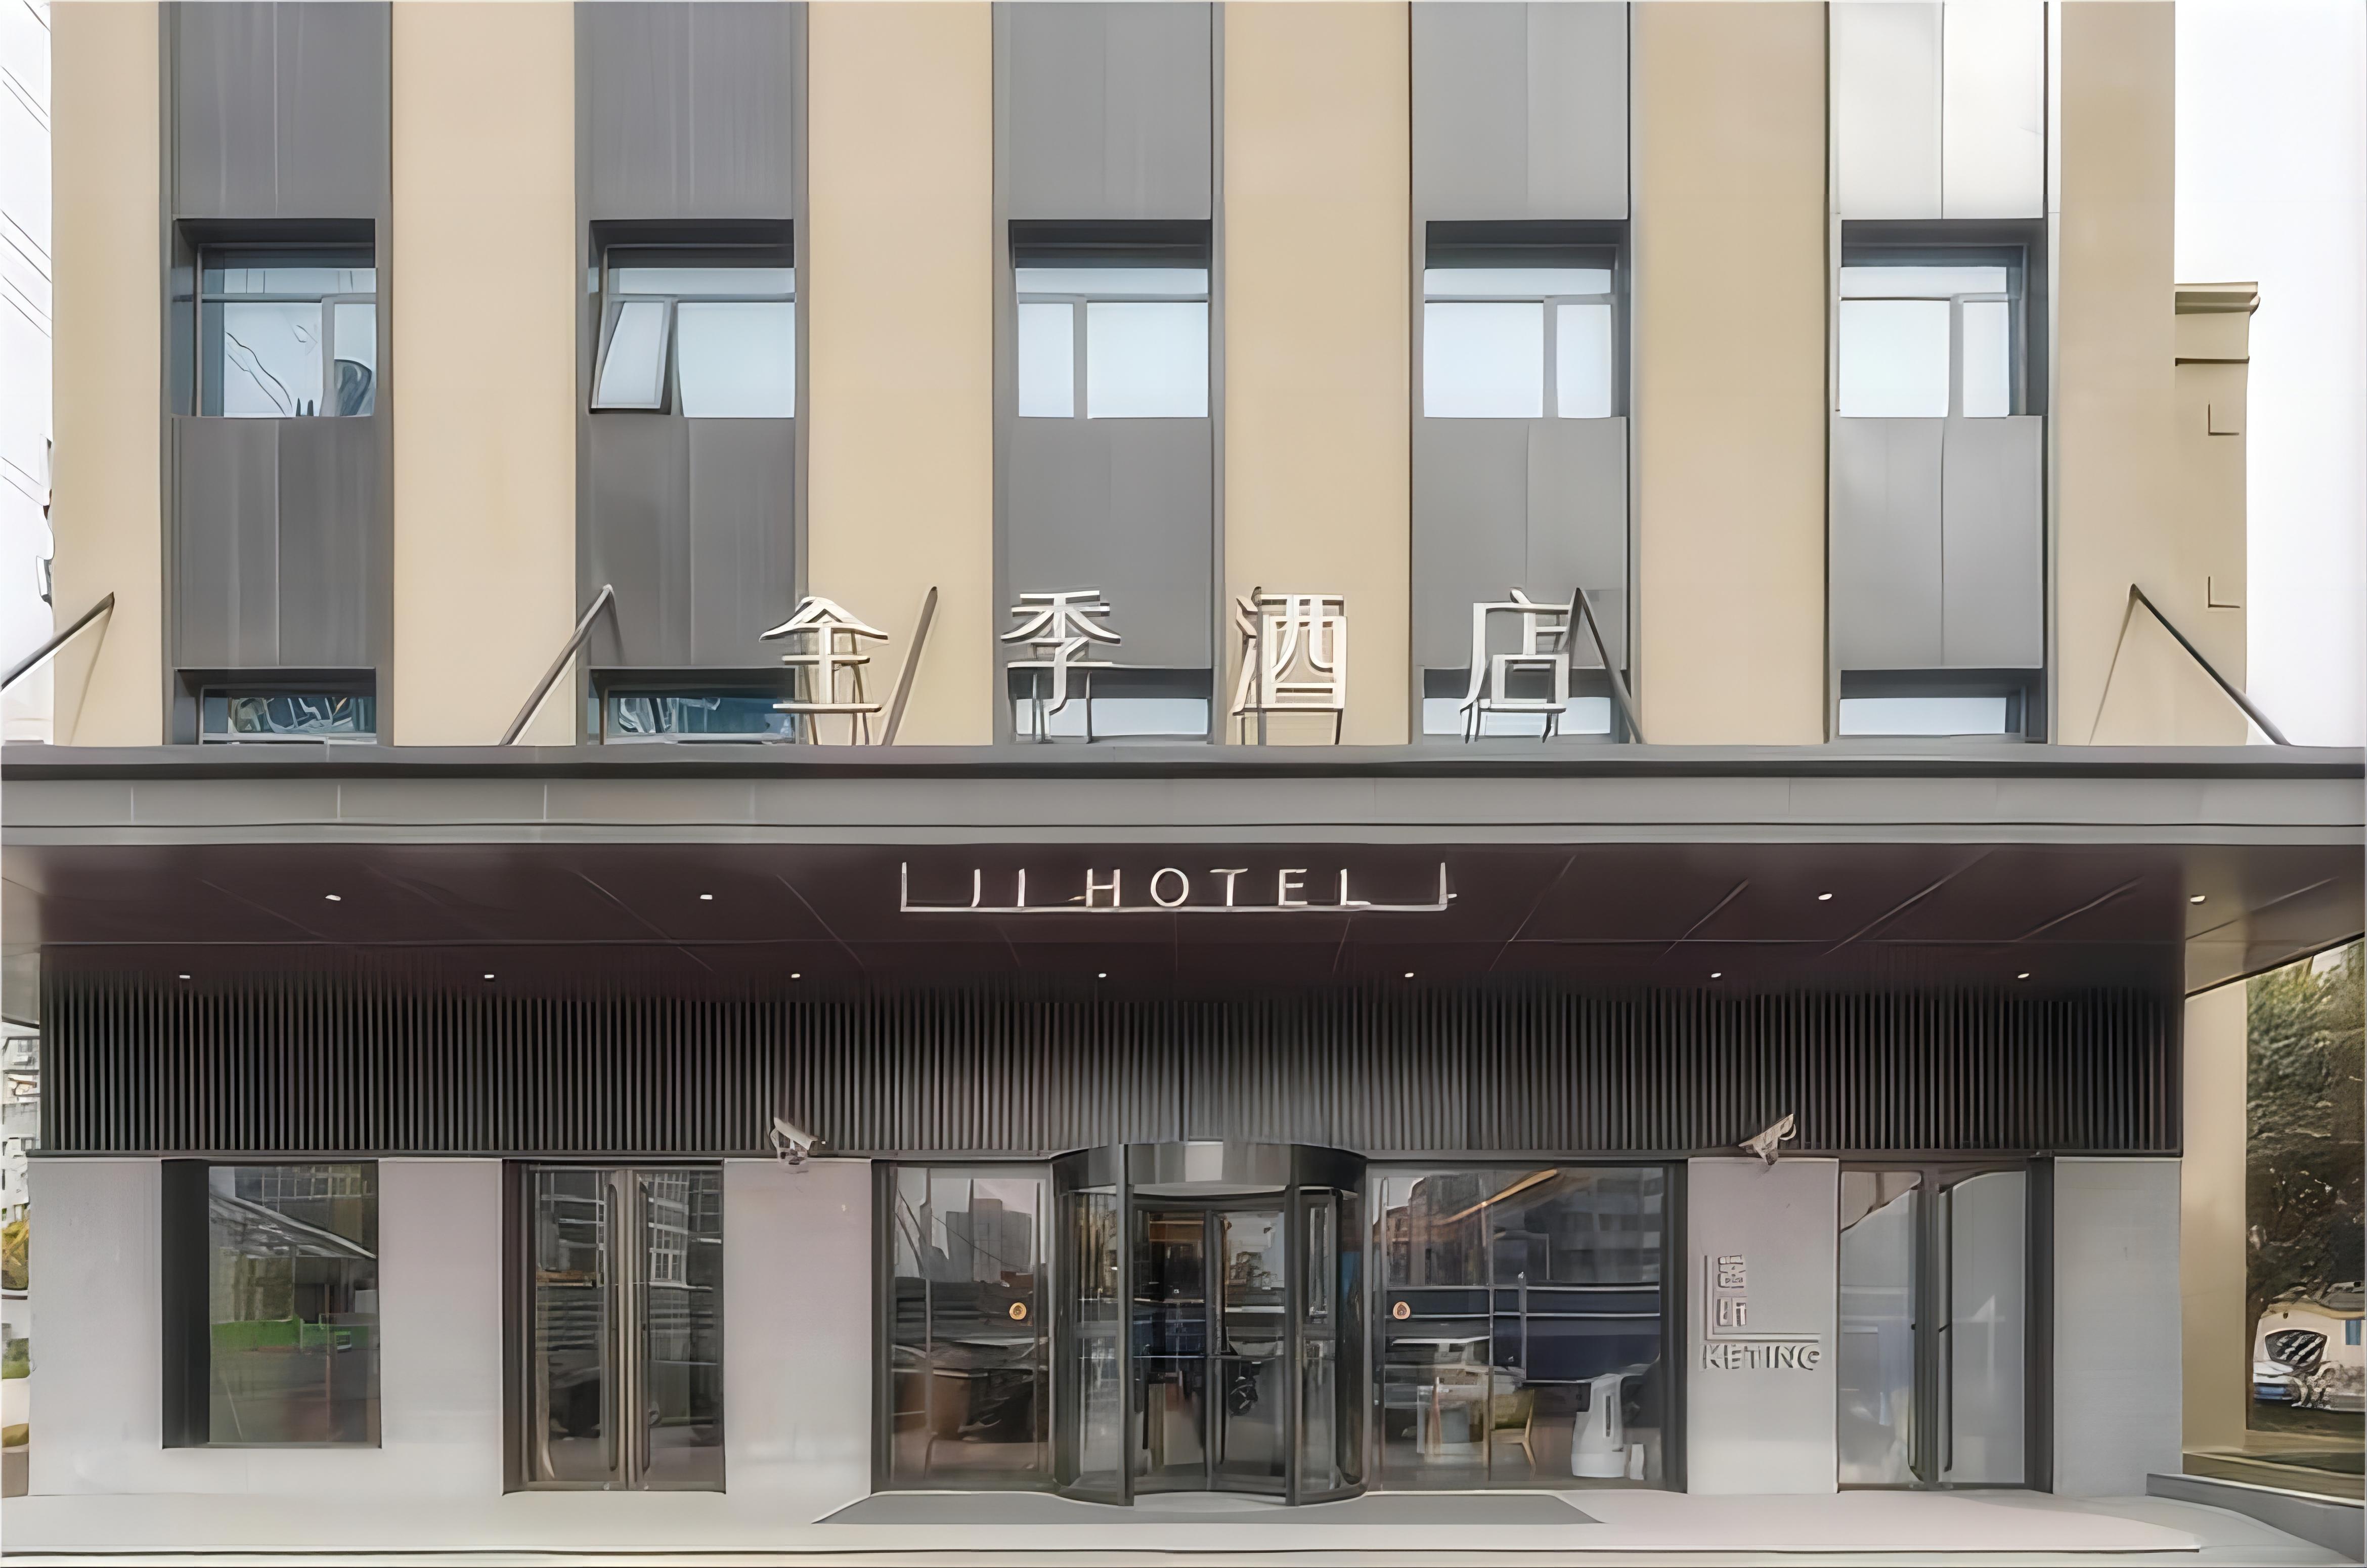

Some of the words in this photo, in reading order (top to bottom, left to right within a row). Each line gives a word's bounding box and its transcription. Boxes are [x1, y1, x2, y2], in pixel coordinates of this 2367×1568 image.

[759, 587, 1570, 715] 全季酒店
[970, 868, 1025, 907] JI
[1086, 867, 1371, 907] HOTEL
[1702, 1344, 1820, 1371] KETING
